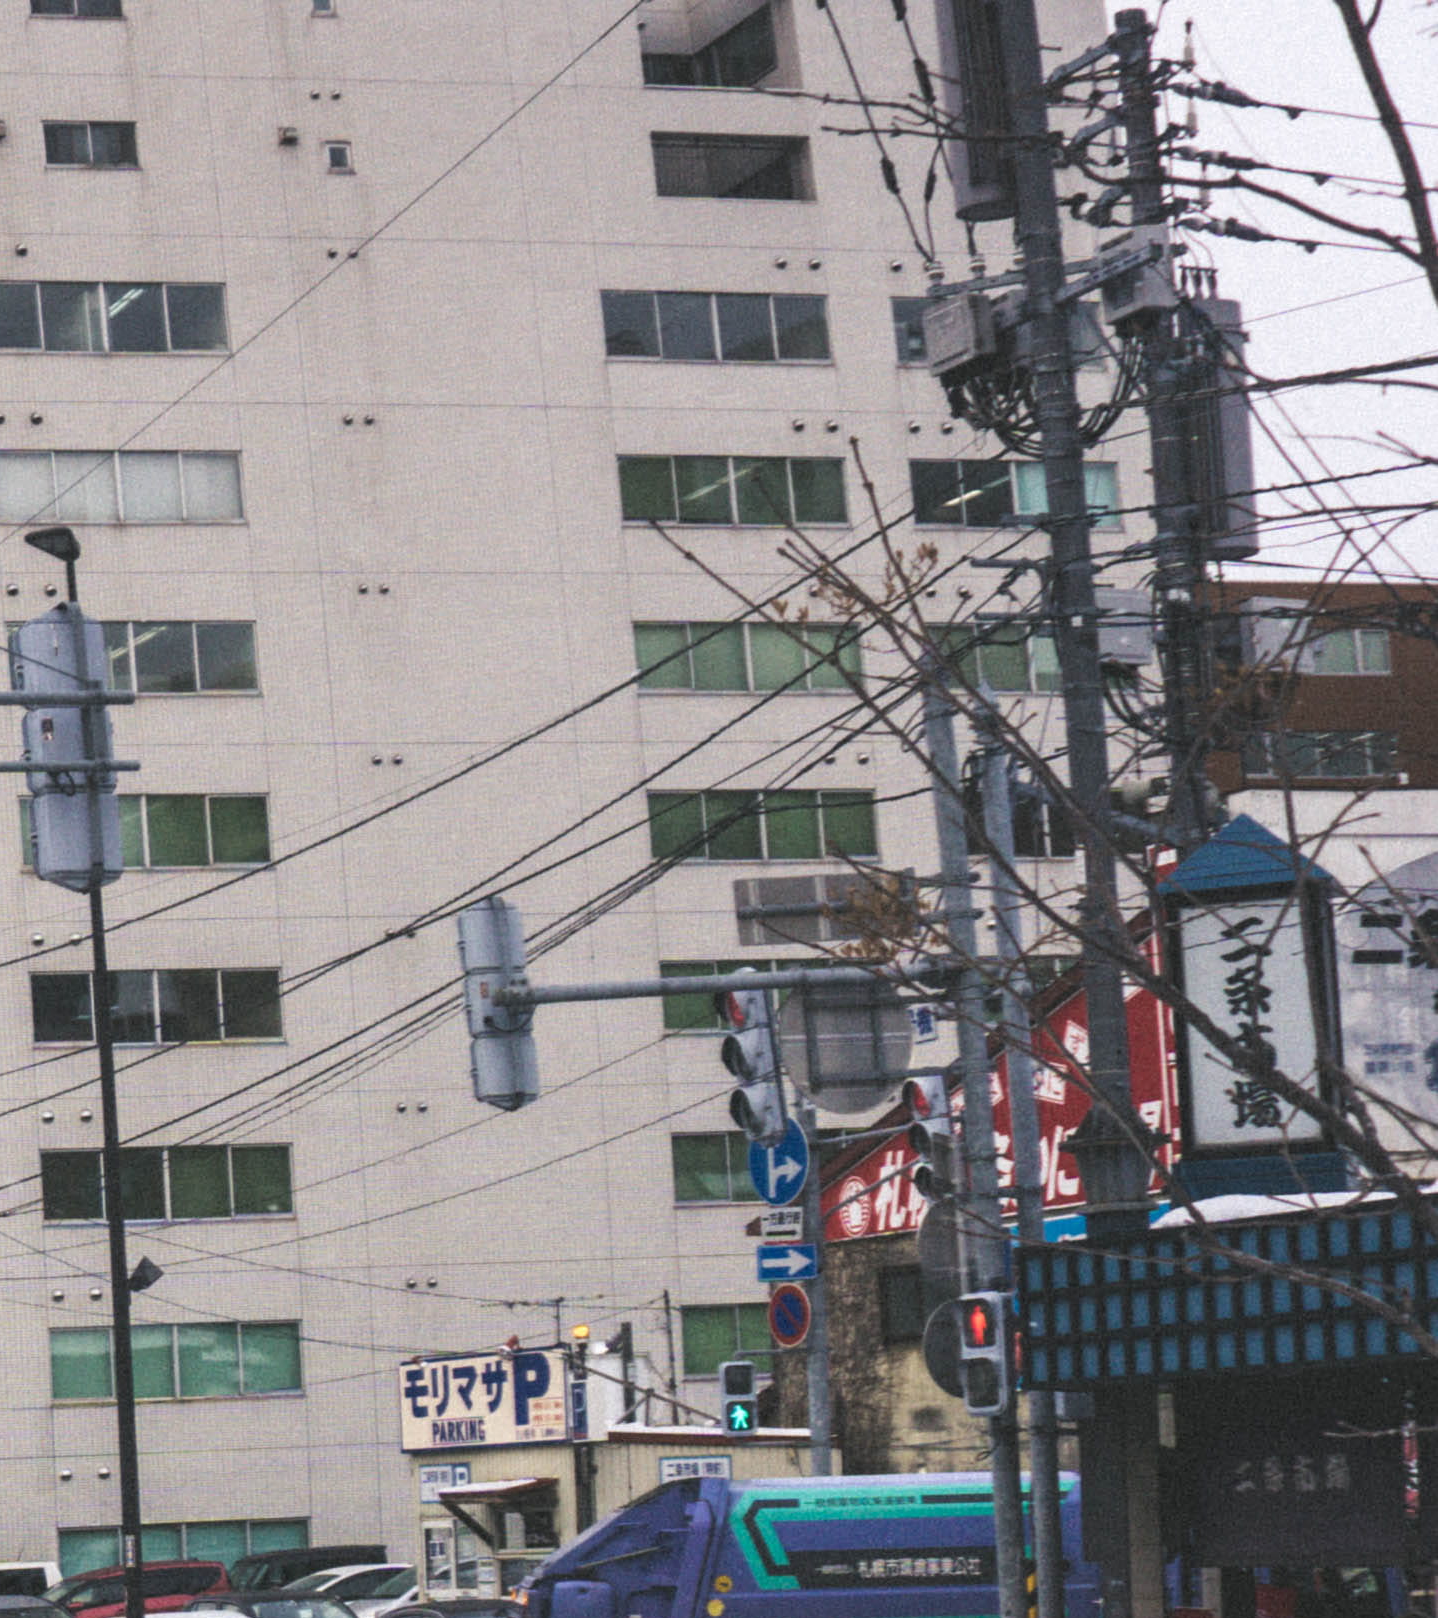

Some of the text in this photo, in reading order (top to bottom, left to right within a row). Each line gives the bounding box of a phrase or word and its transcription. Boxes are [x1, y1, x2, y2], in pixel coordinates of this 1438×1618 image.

[405, 1352, 550, 1426] モリマサ P
[432, 1419, 486, 1443] PARKING
